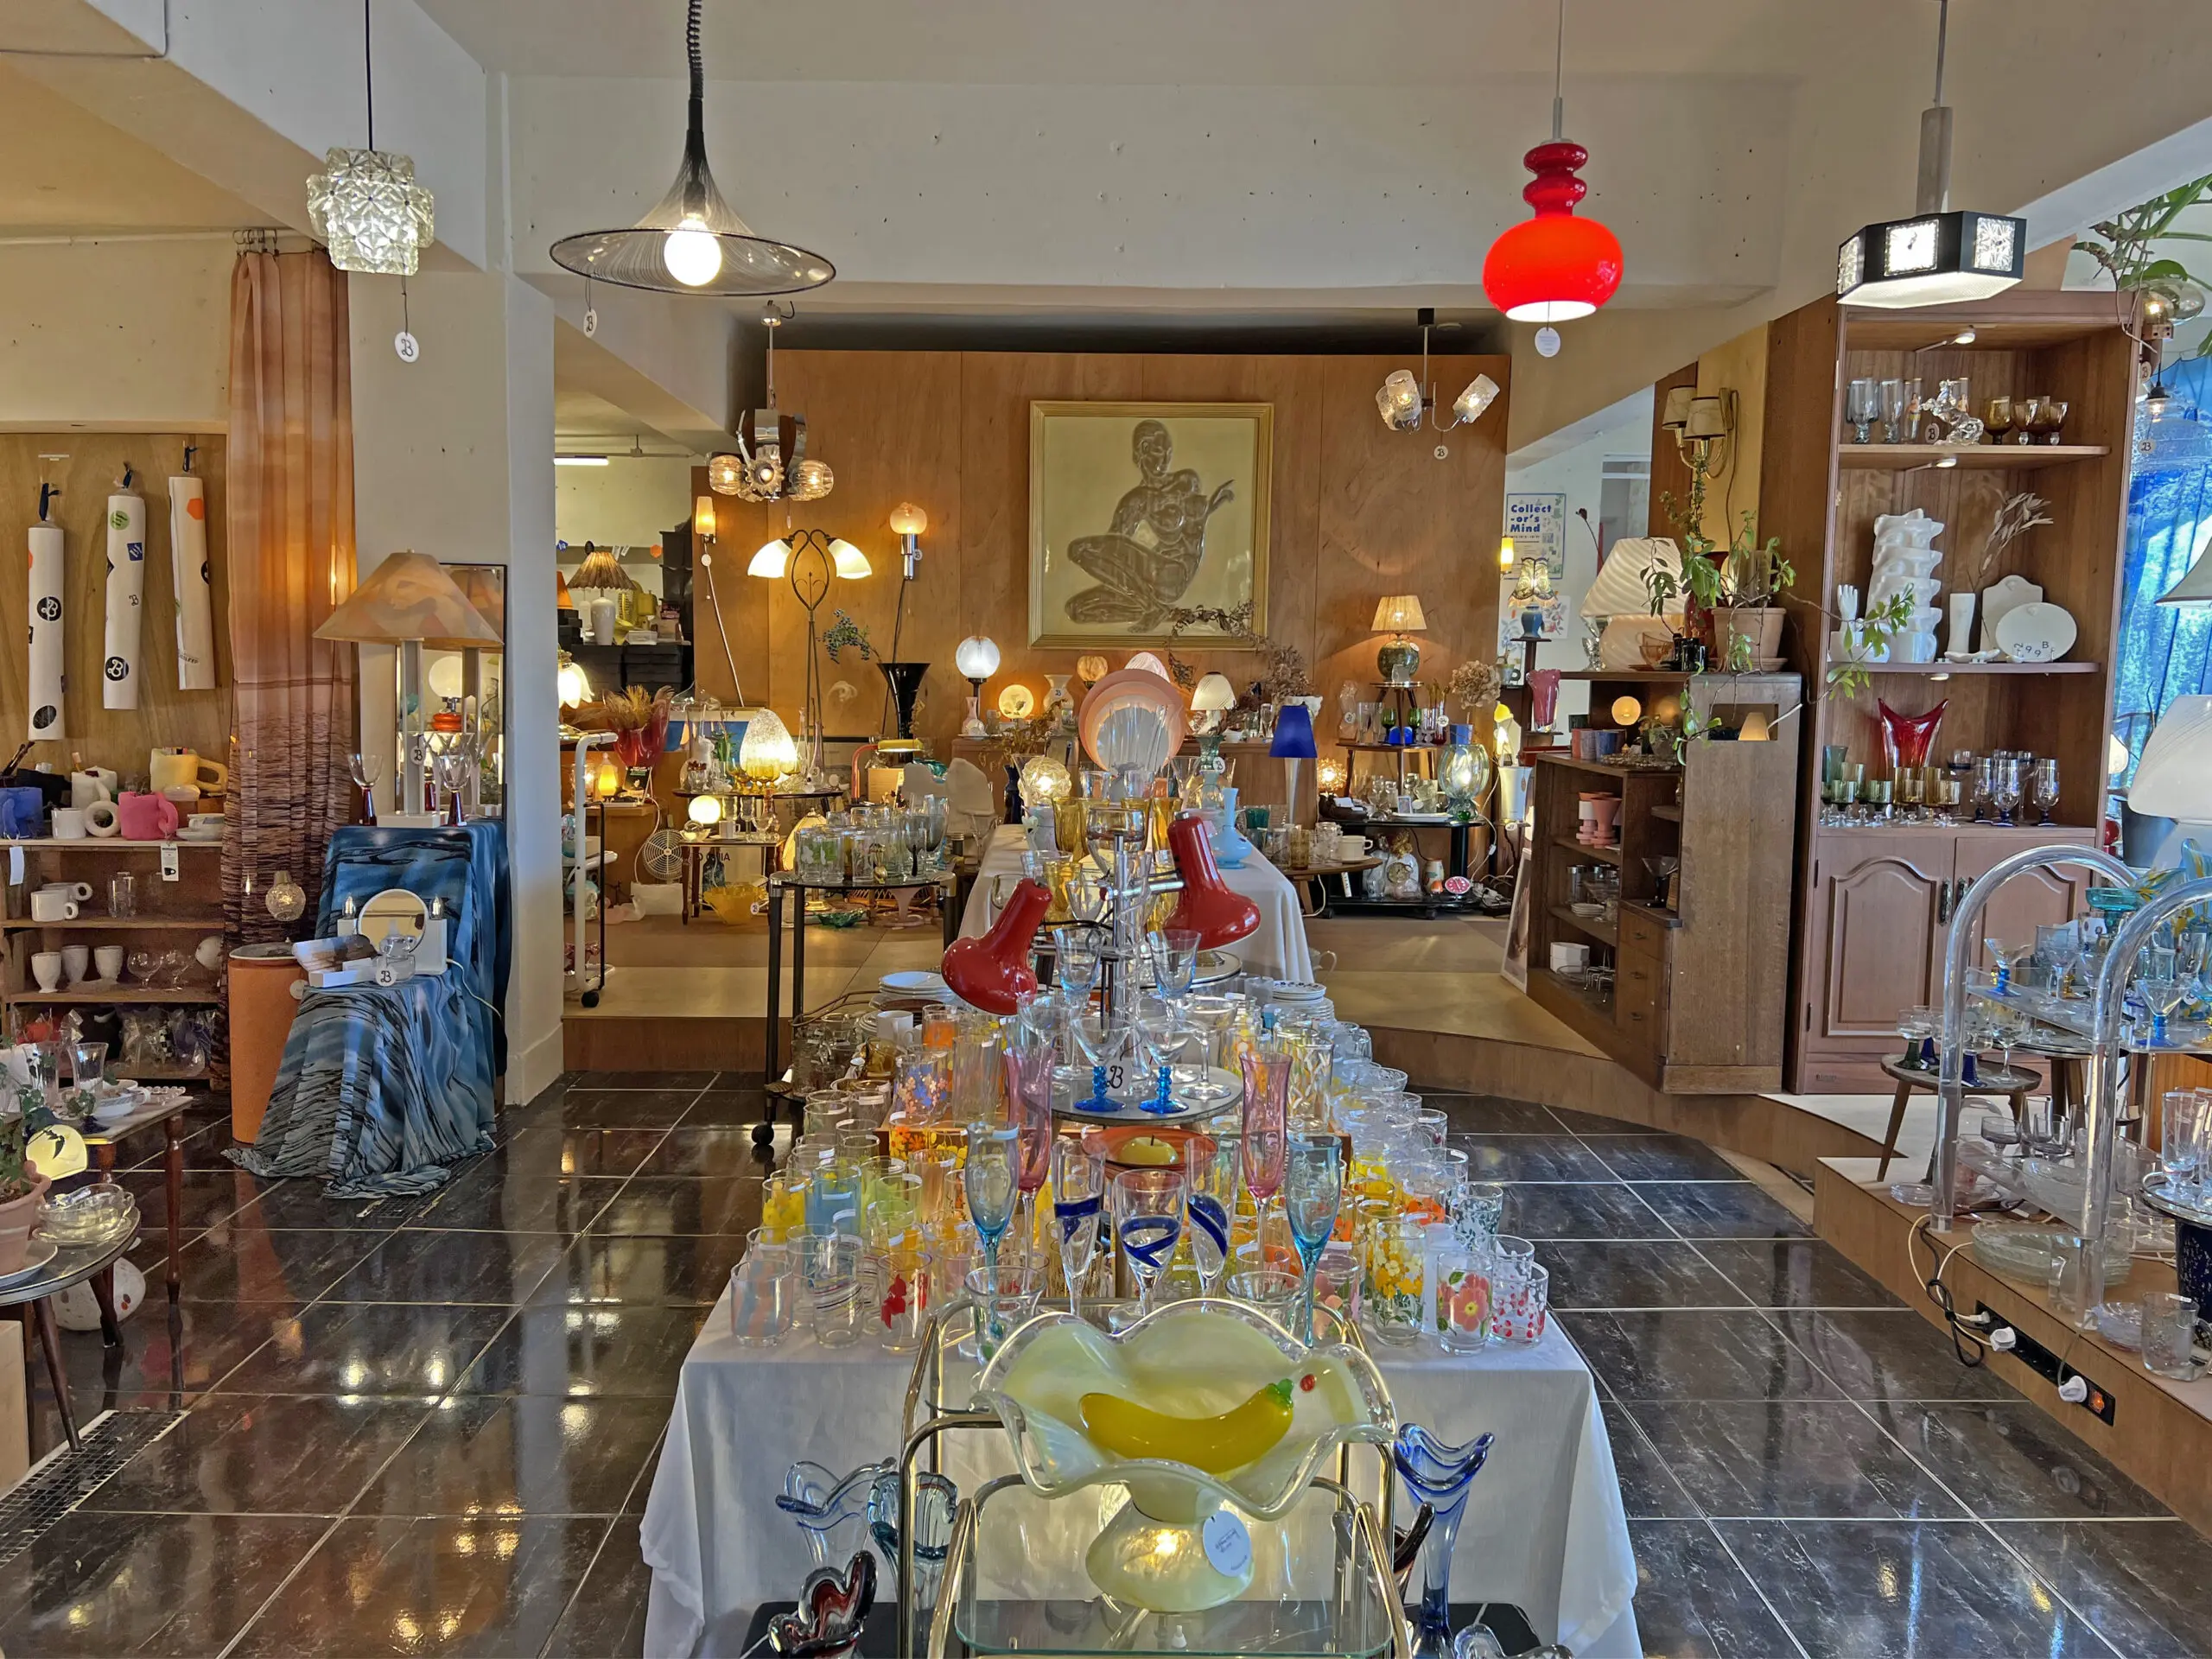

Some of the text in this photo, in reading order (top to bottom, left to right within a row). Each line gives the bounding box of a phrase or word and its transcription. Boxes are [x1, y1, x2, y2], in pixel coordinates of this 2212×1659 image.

[587, 315, 593, 332] B
[401, 338, 413, 356] B
[1929, 428, 1935, 440] B
[1510, 524, 1541, 532] Mind
[129, 594, 138, 607] B
[41, 599, 57, 618] B
[108, 659, 124, 677] B
[414, 749, 423, 760] B
[381, 970, 391, 982] B
[1108, 1065, 1123, 1089] B
